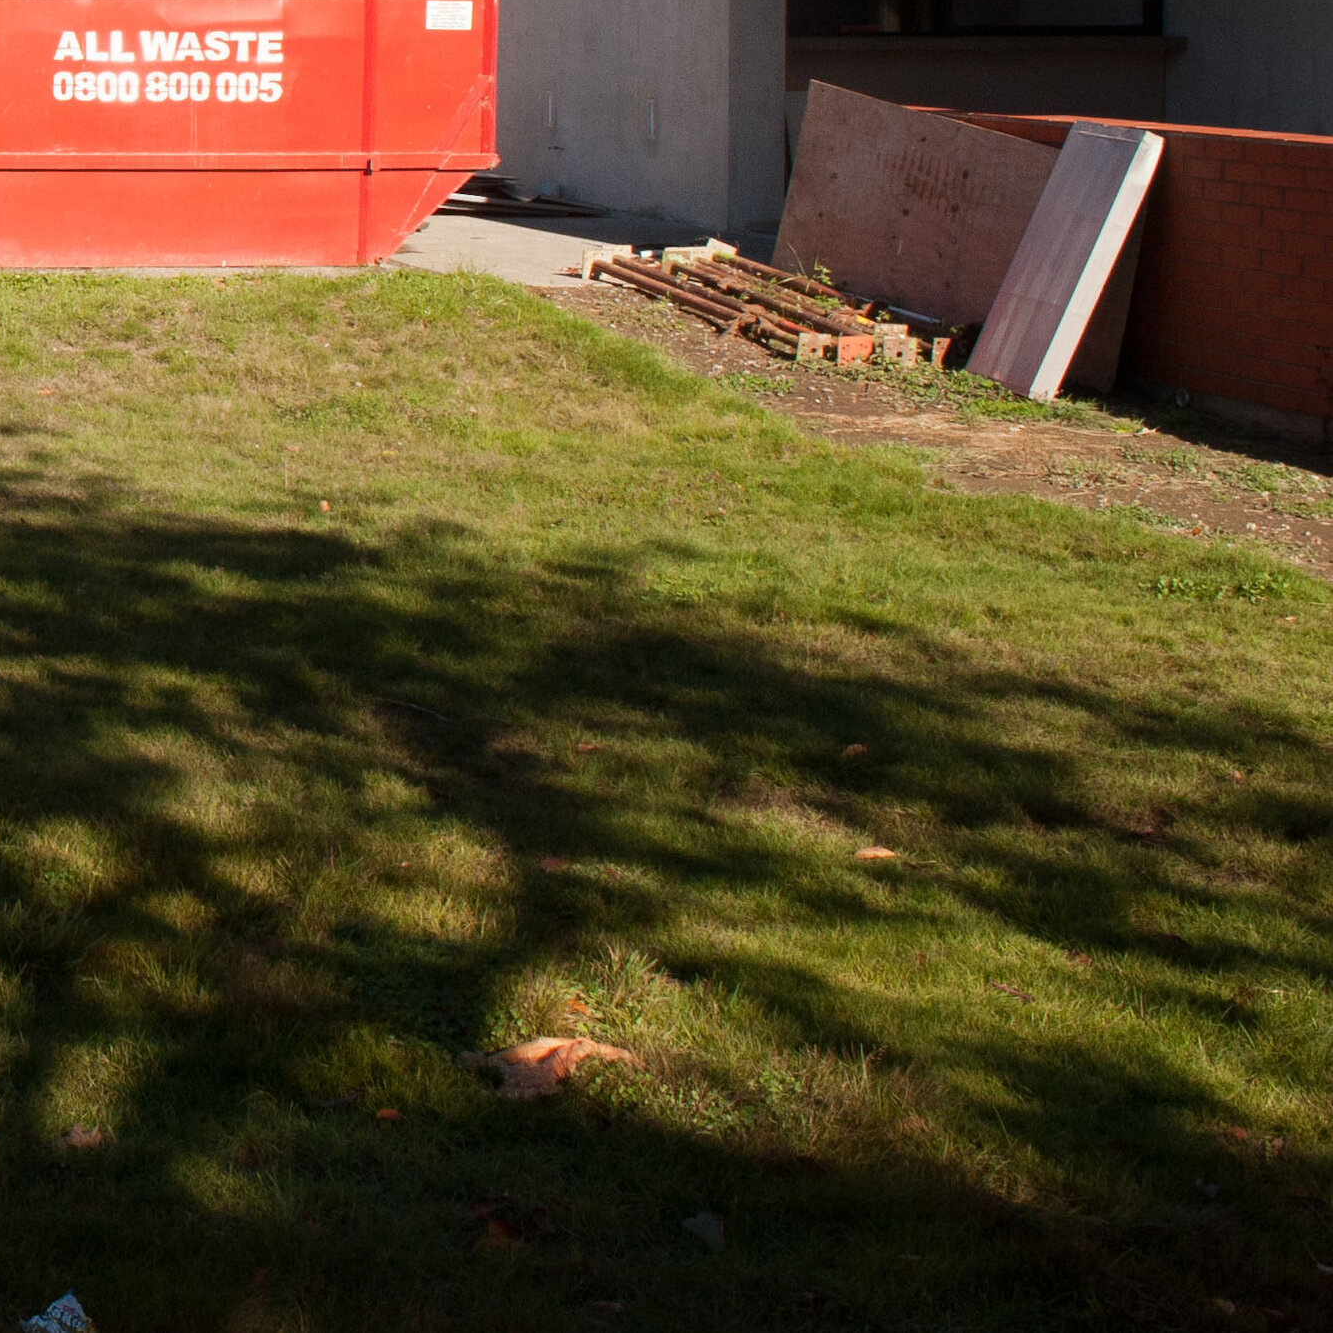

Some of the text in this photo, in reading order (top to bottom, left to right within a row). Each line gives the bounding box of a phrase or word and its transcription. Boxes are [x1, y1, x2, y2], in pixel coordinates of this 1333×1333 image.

[53, 30, 284, 63] ALL WASTE
[52, 71, 283, 103] 0800 800 005
